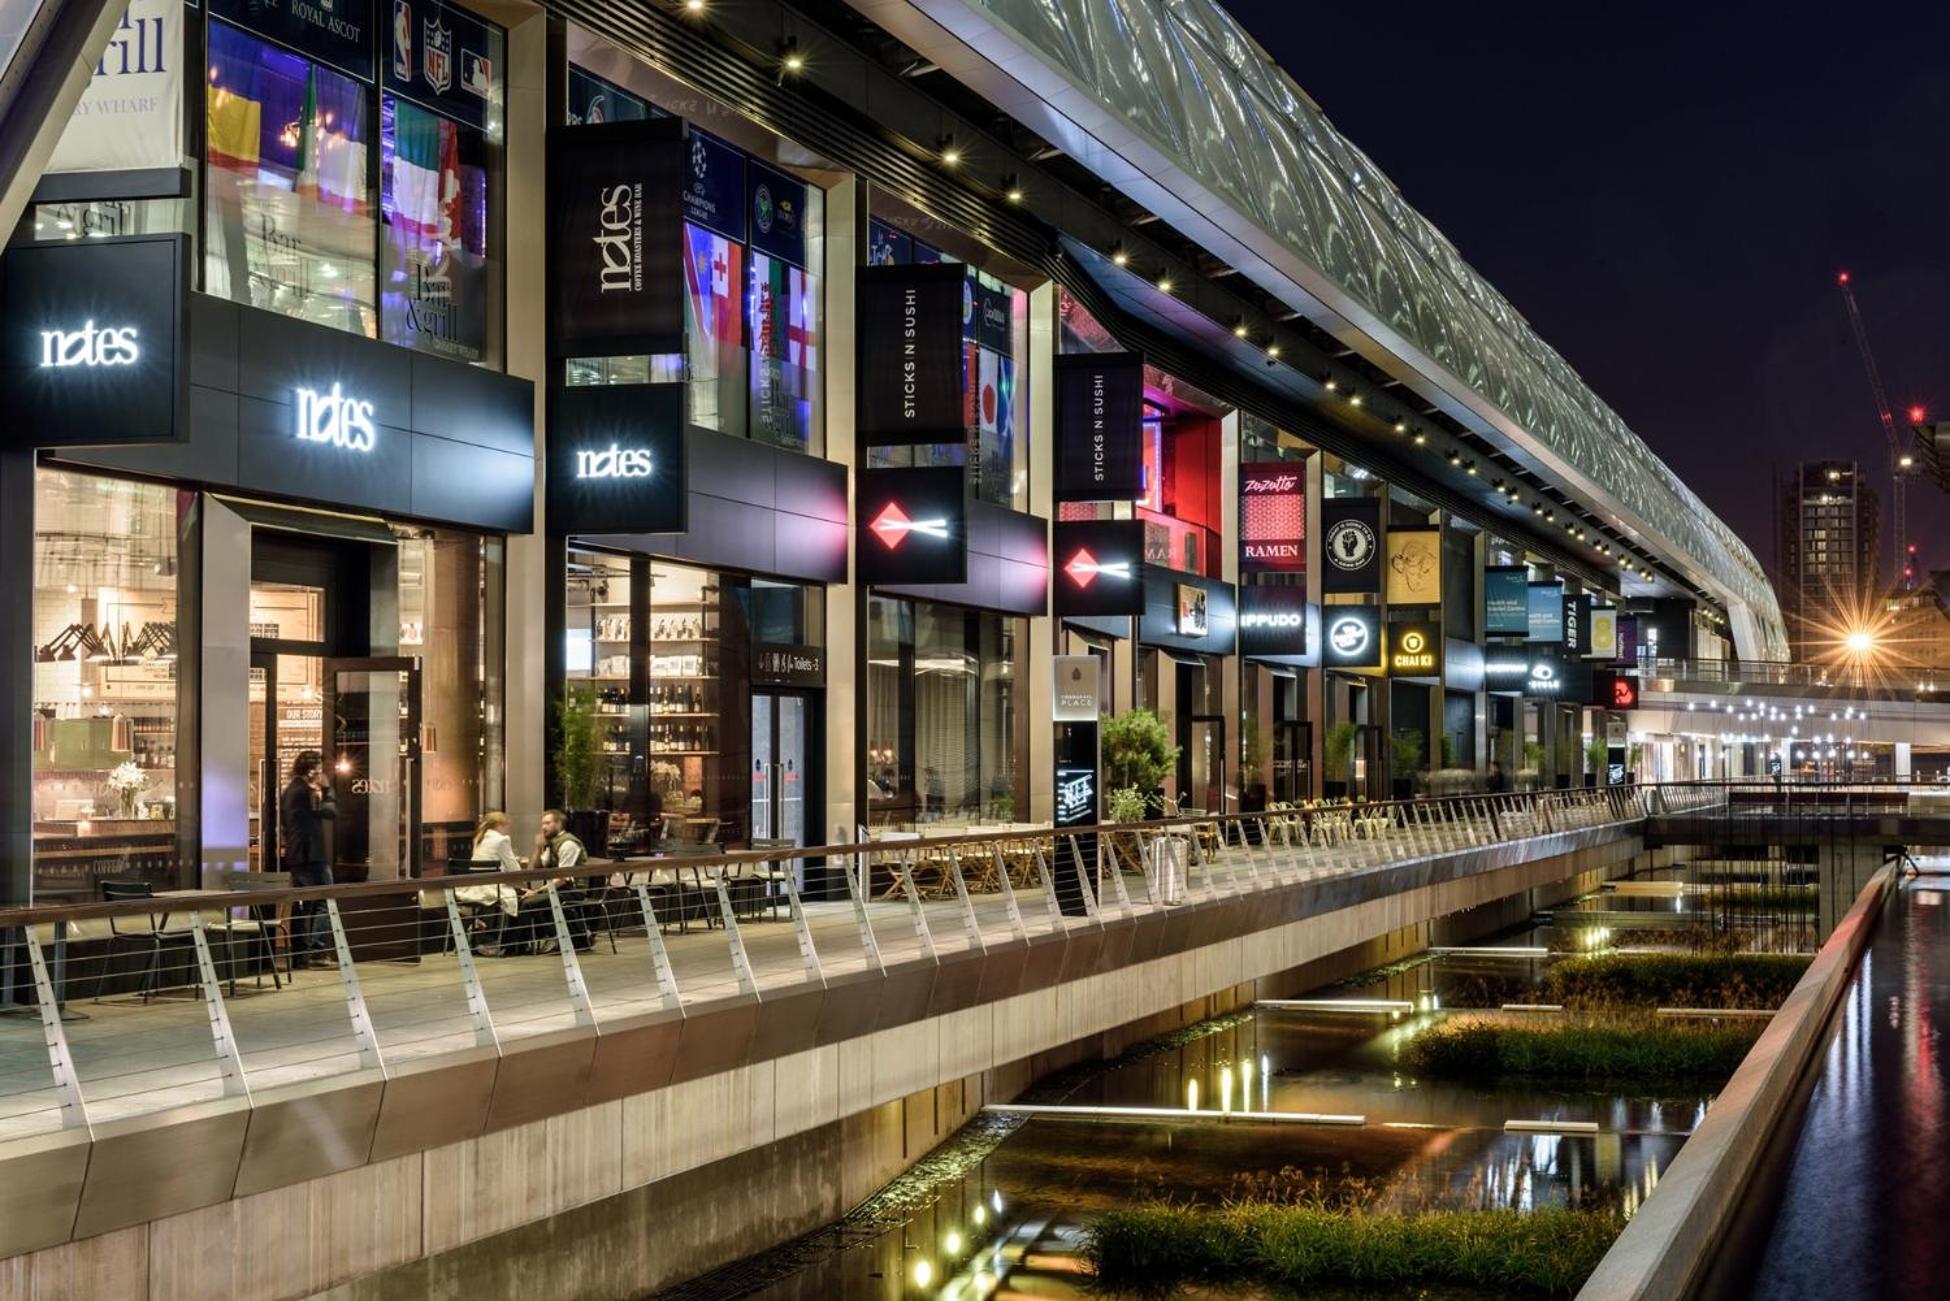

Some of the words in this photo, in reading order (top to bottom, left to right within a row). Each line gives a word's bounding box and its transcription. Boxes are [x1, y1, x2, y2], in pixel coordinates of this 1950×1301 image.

[292, 2, 325, 28] ROYAL
[328, 16, 361, 43] ASCOT
[97, 97, 158, 114] WHARF
[592, 184, 632, 293] notes
[904, 289, 916, 338] SUSHI
[40, 319, 139, 367] notes
[904, 361, 916, 418] STICKS
[1094, 375, 1104, 415] SUSHI
[296, 382, 375, 451] notes
[576, 443, 652, 478] notes
[1094, 434, 1104, 481] STICKS
[1245, 545, 1298, 557] RAMEN
[1240, 614, 1301, 627] IPPUDO
[1567, 600, 1576, 649] TIGER
[1394, 655, 1419, 667] CHAI
[1420, 655, 1432, 667] KI
